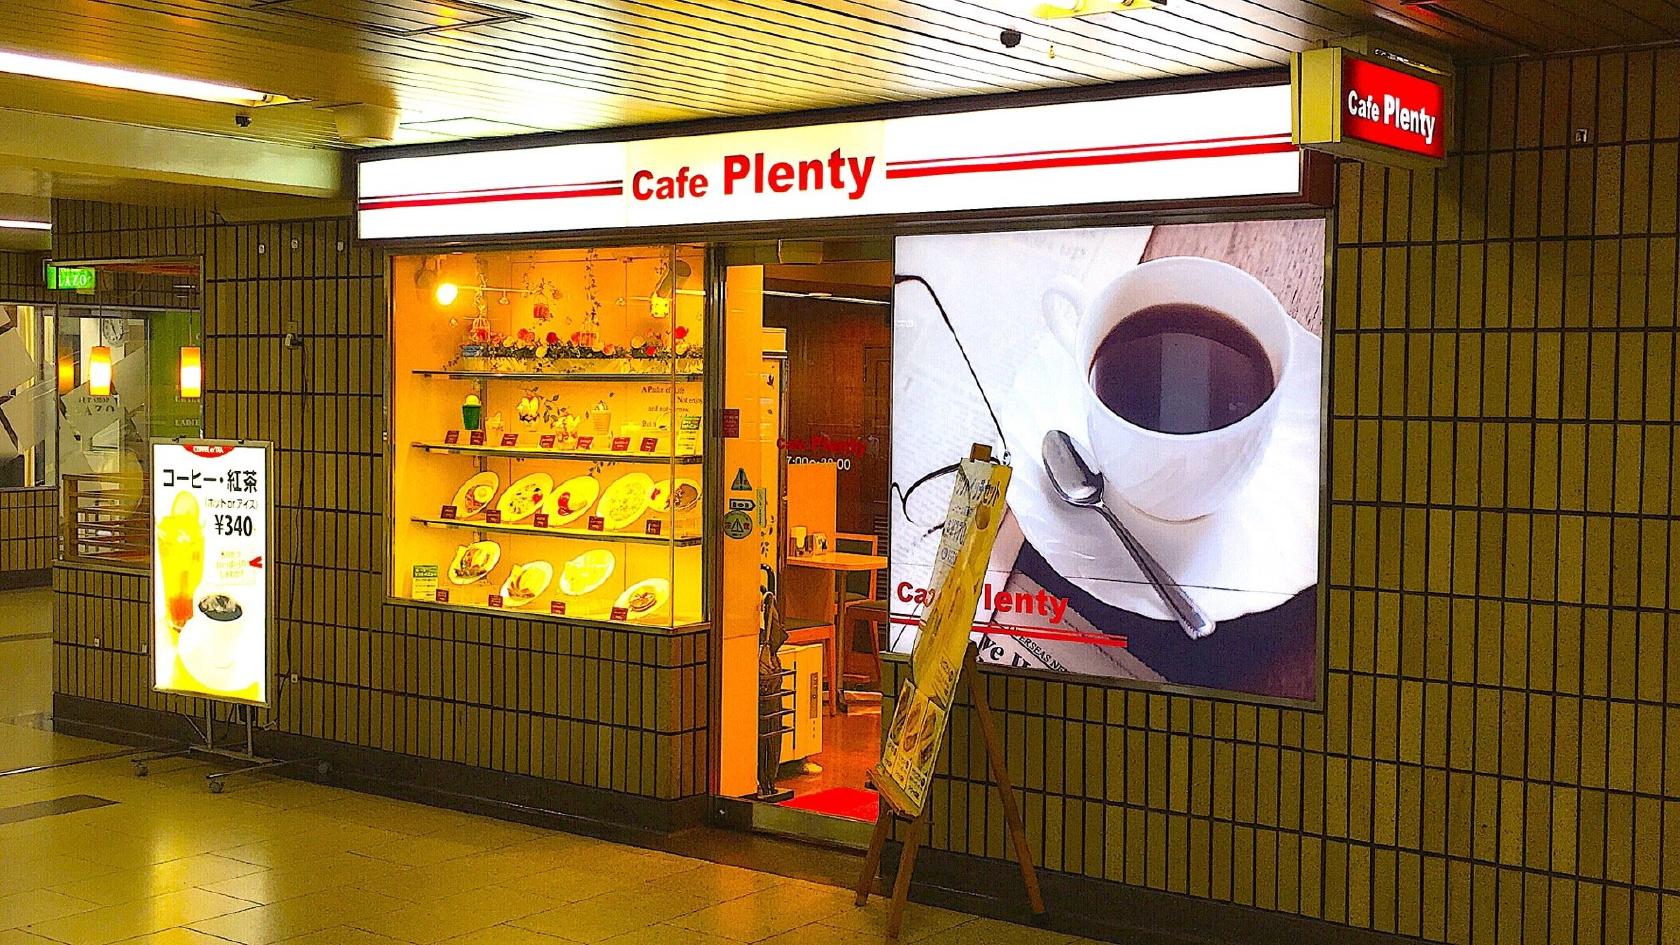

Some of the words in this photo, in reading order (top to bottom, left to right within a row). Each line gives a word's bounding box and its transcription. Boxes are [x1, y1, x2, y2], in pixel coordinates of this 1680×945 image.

[1348, 90, 1379, 122] Cafe
[1383, 94, 1435, 144] Plenty
[632, 166, 708, 200] Cafe
[723, 148, 876, 200] Plenty
[163, 469, 257, 493] コーヒー・紅茶
[215, 514, 253, 536] ¥340
[984, 583, 1069, 624] lenty
[1018, 636, 1052, 662] ERSEAS
